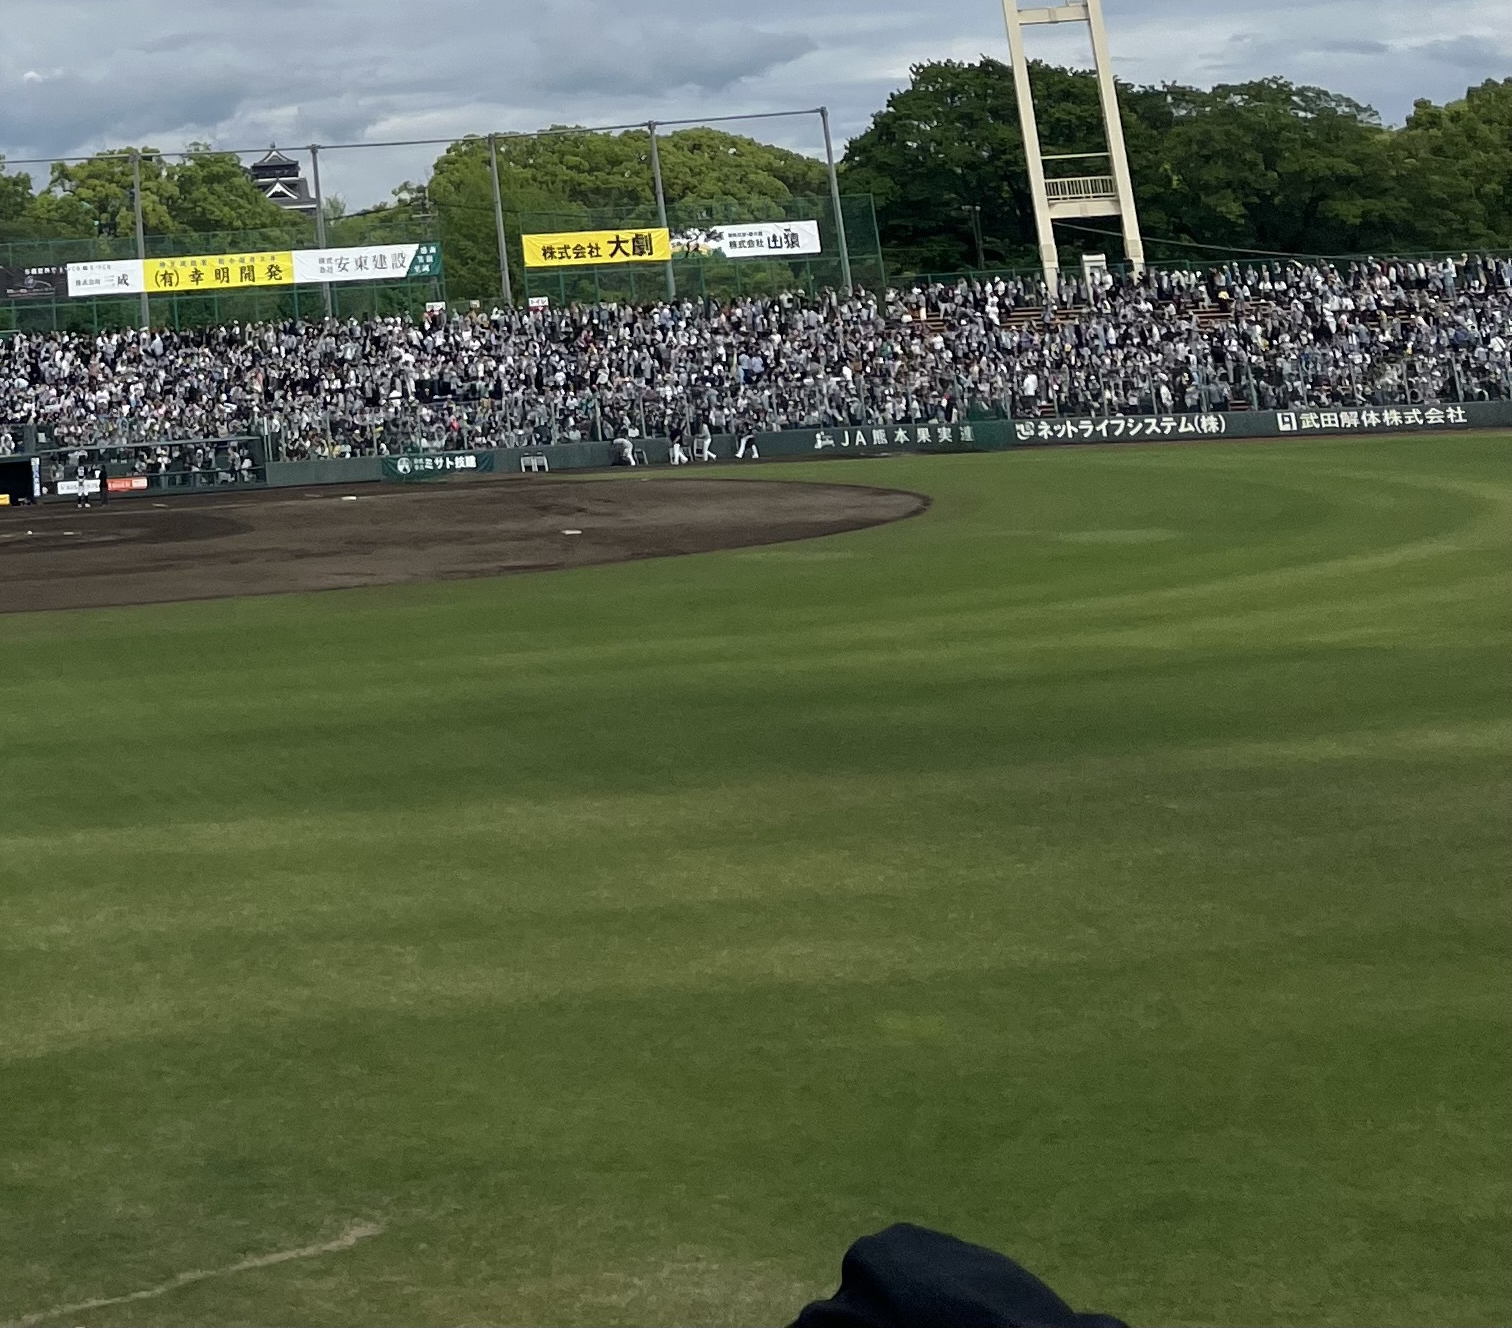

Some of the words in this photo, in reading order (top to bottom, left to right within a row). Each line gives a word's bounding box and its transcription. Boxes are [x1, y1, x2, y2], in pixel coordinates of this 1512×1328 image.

[542, 242, 603, 261] 株式会社
[607, 233, 654, 259] 大劇
[334, 252, 407, 273] 安東建設
[1037, 414, 1226, 440] ネットライフシステム(株)
[1299, 406, 1468, 430] 武田解体株式会社
